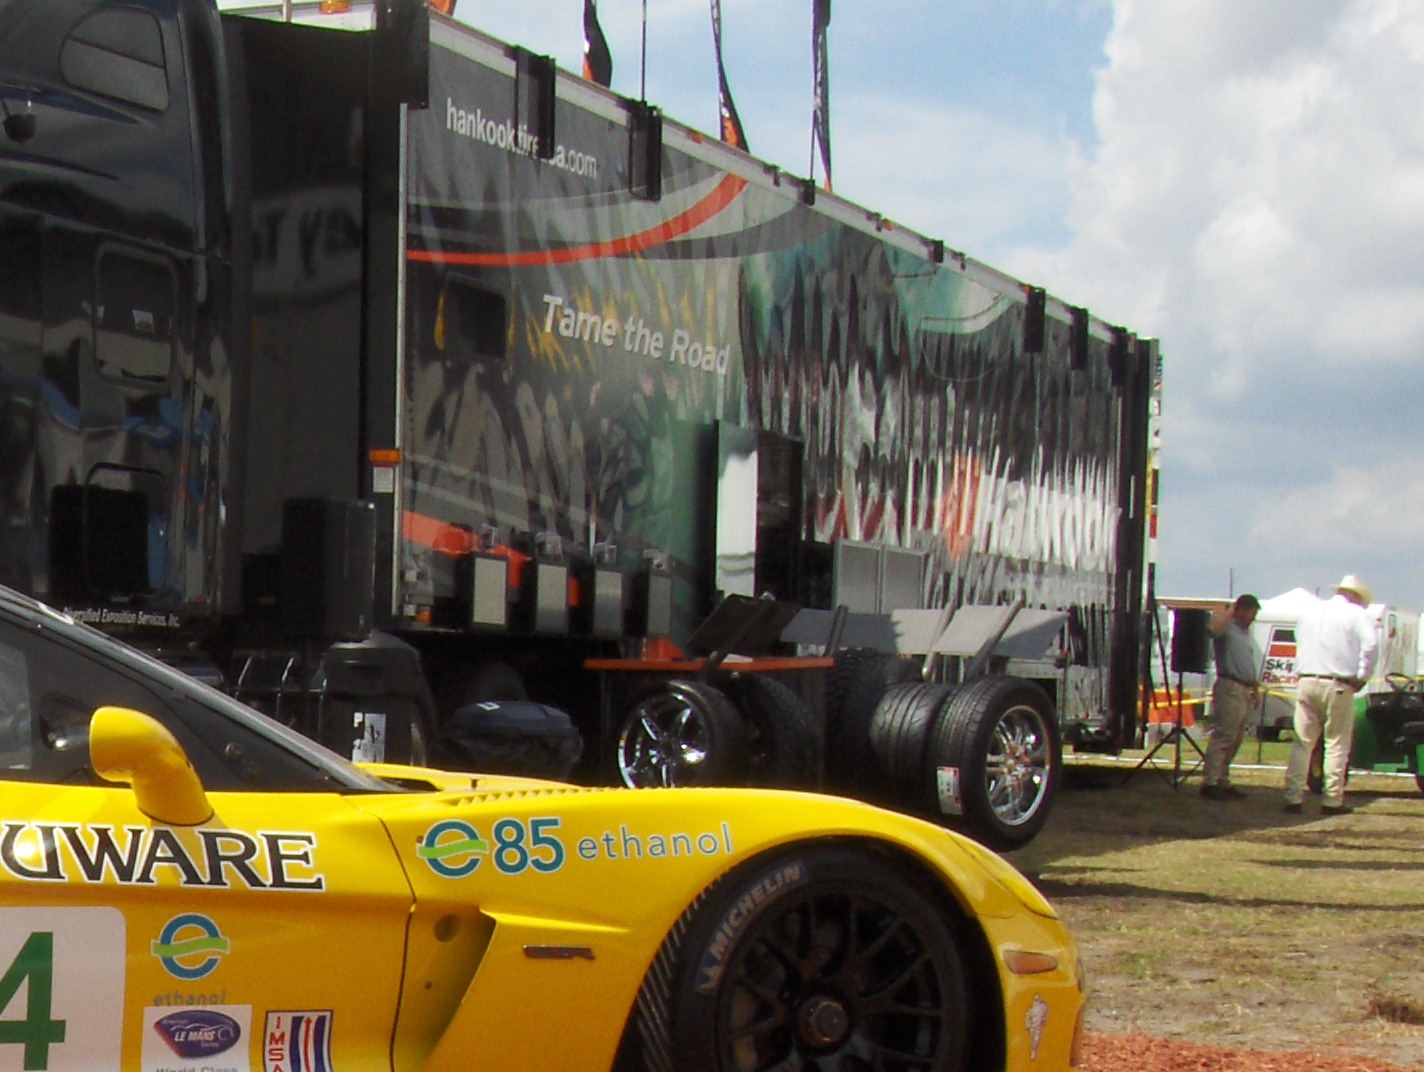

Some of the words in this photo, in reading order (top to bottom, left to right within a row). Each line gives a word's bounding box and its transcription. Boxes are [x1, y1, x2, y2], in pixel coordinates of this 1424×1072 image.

[446, 97, 597, 179] hankooktirea.com
[543, 294, 617, 346] Tame
[624, 316, 664, 358] the
[670, 328, 731, 375] Road
[578, 822, 733, 861] ethanol
[708, 862, 804, 960] MICHELIN
[153, 989, 226, 1006] ethanol
